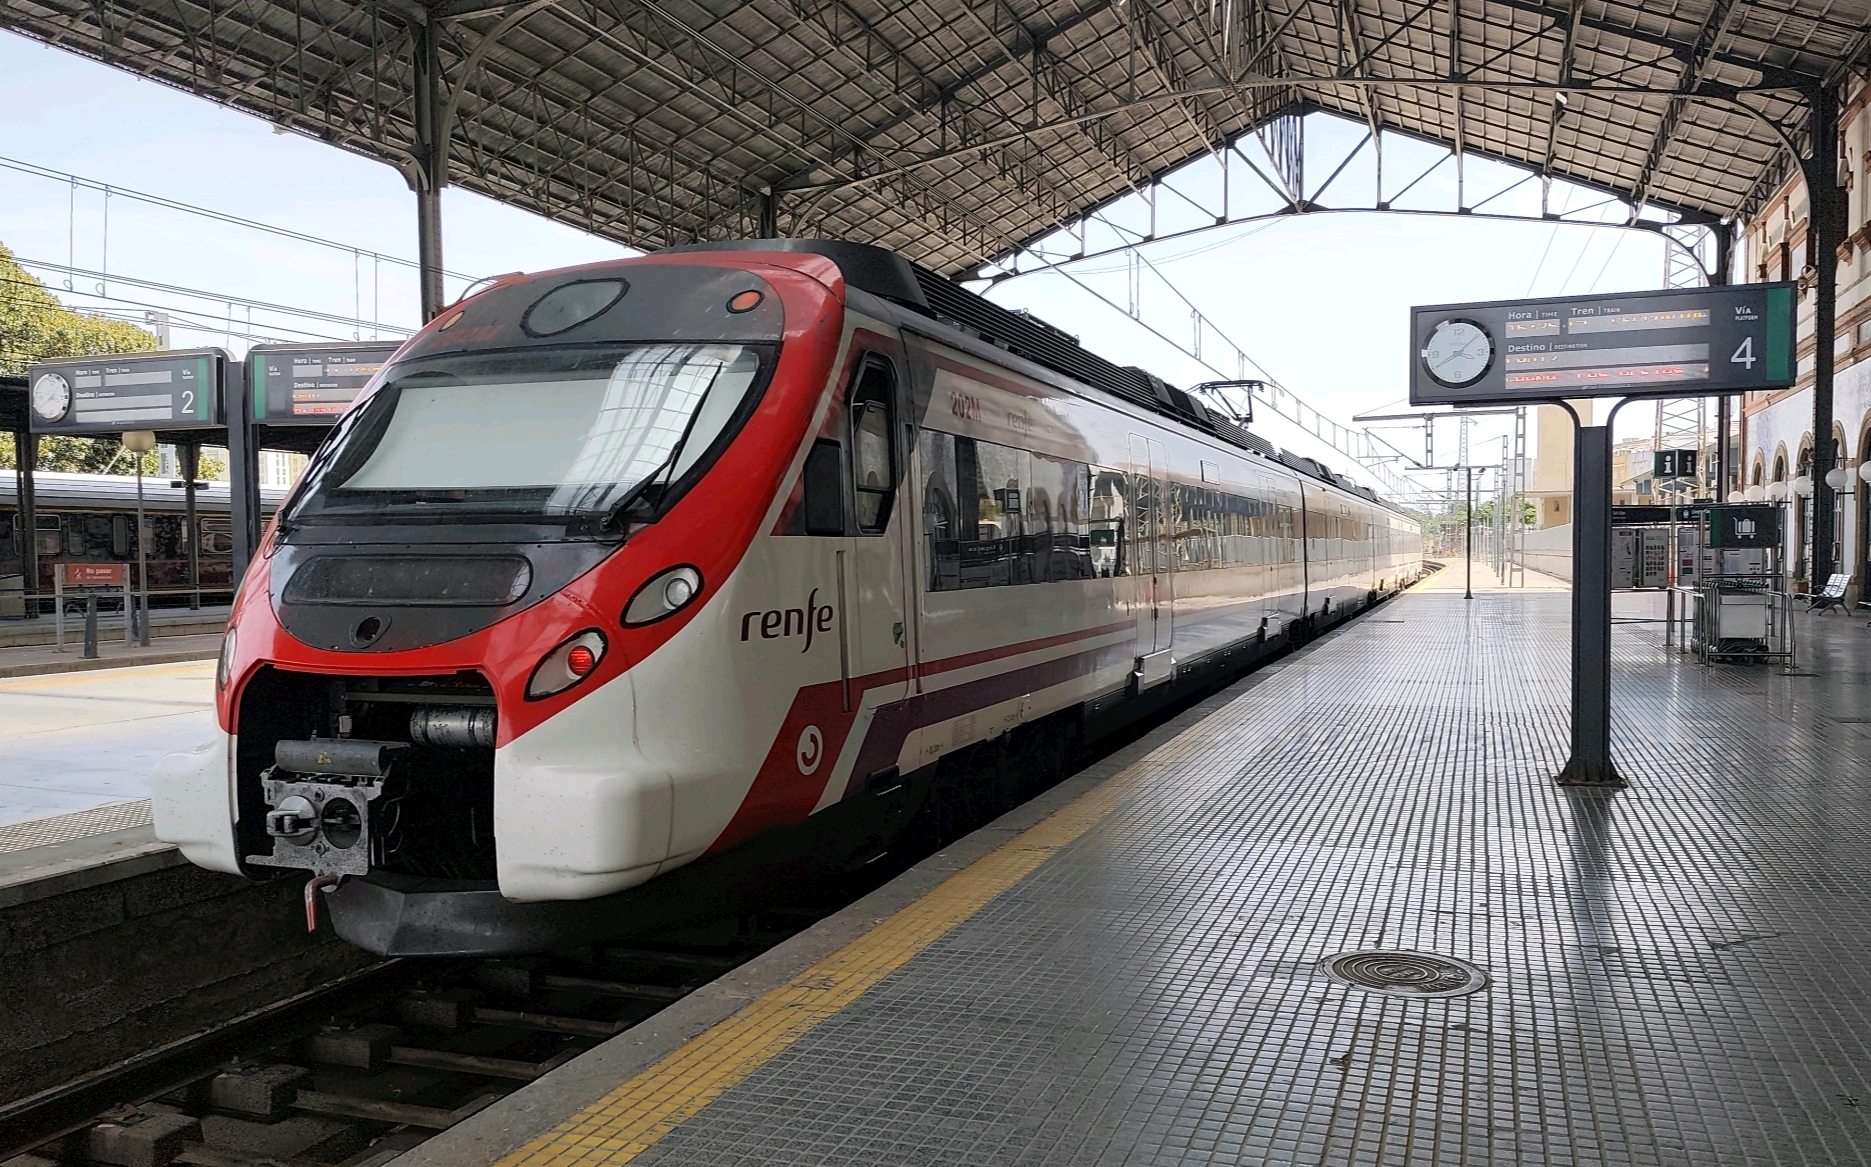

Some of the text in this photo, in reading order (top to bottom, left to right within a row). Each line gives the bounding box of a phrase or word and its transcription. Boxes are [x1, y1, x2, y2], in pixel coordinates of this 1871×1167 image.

[1508, 312, 1532, 320] Hora
[1571, 307, 1594, 315] Tren
[1453, 328, 1465, 336] 12
[1431, 349, 1485, 359] 9 3
[1508, 343, 1546, 353] Destino
[1731, 336, 1757, 370] 4
[181, 390, 194, 414] 2
[951, 391, 982, 422] 202M
[1007, 408, 1033, 440] renfe
[740, 587, 834, 654] renfe
